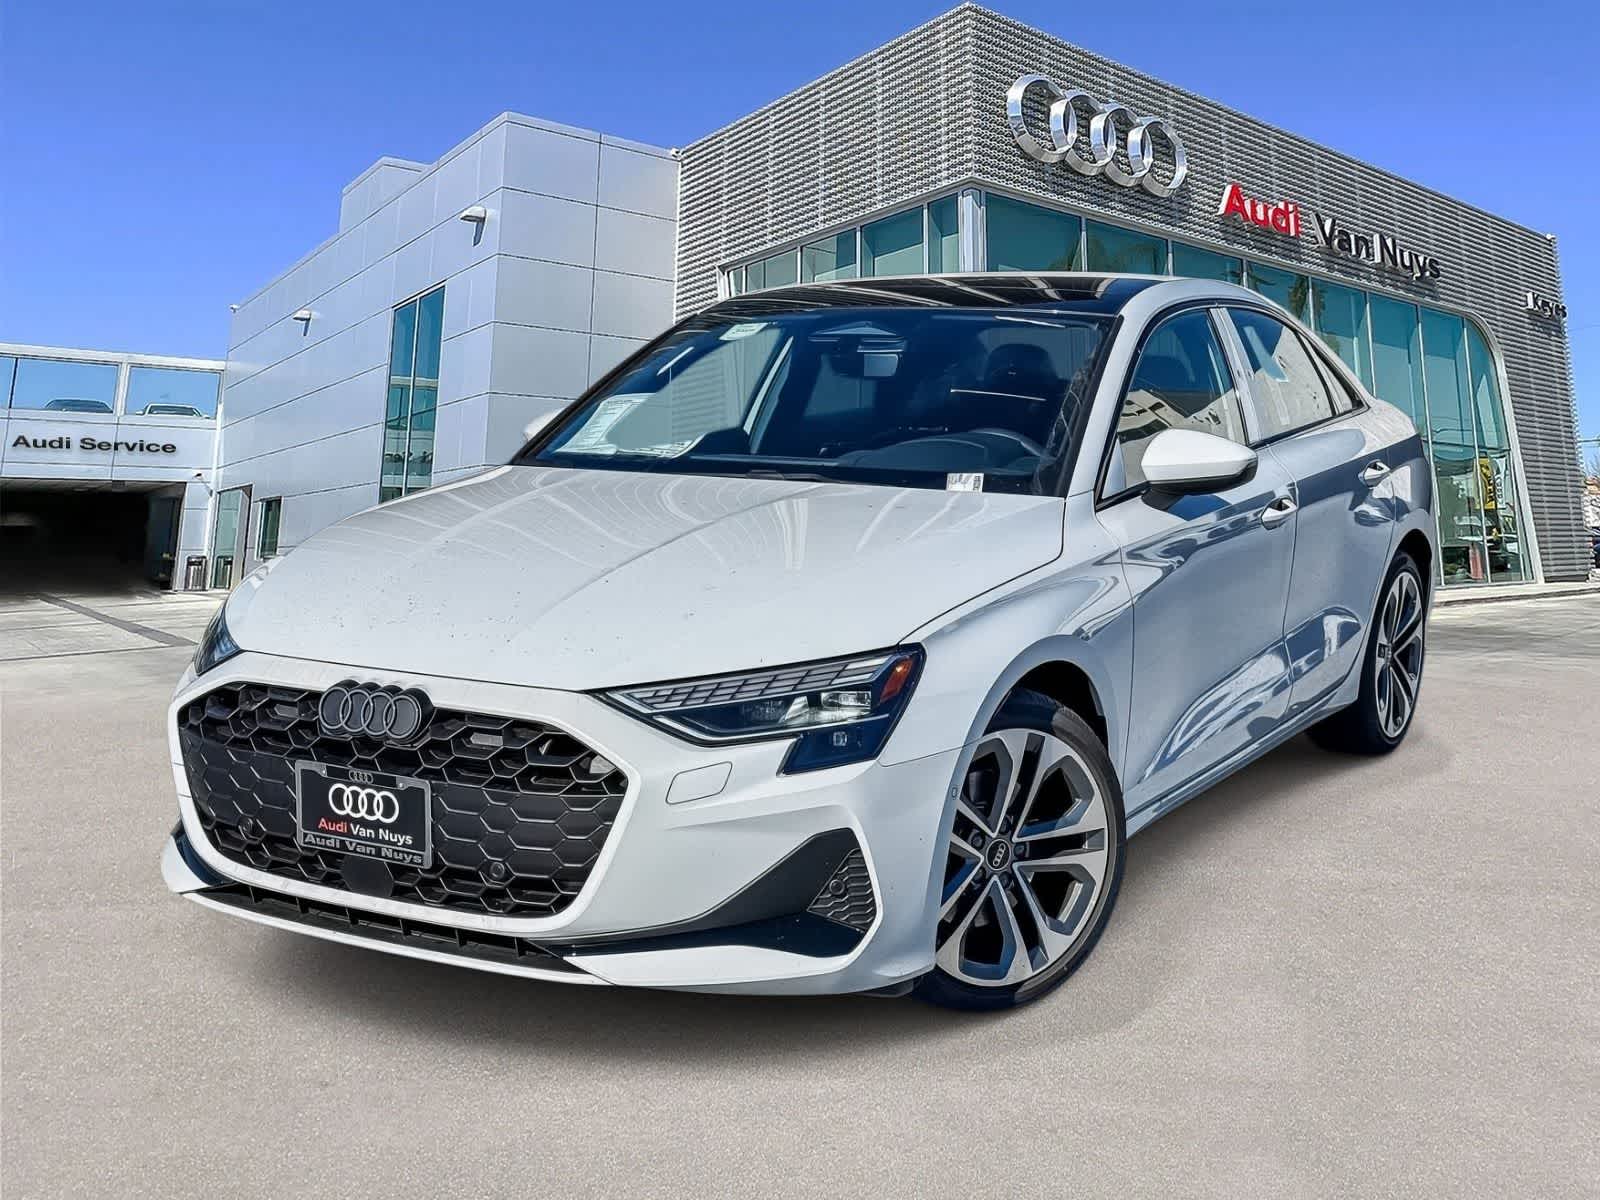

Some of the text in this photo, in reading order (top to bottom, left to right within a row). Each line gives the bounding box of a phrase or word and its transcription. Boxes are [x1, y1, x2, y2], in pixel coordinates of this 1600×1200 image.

[1217, 183, 1441, 280] Audi Van Nuys
[12, 434, 177, 454] Audi Service
[318, 817, 413, 845] Audi Van Nuys
[304, 833, 422, 863] Audi Van Nuys
